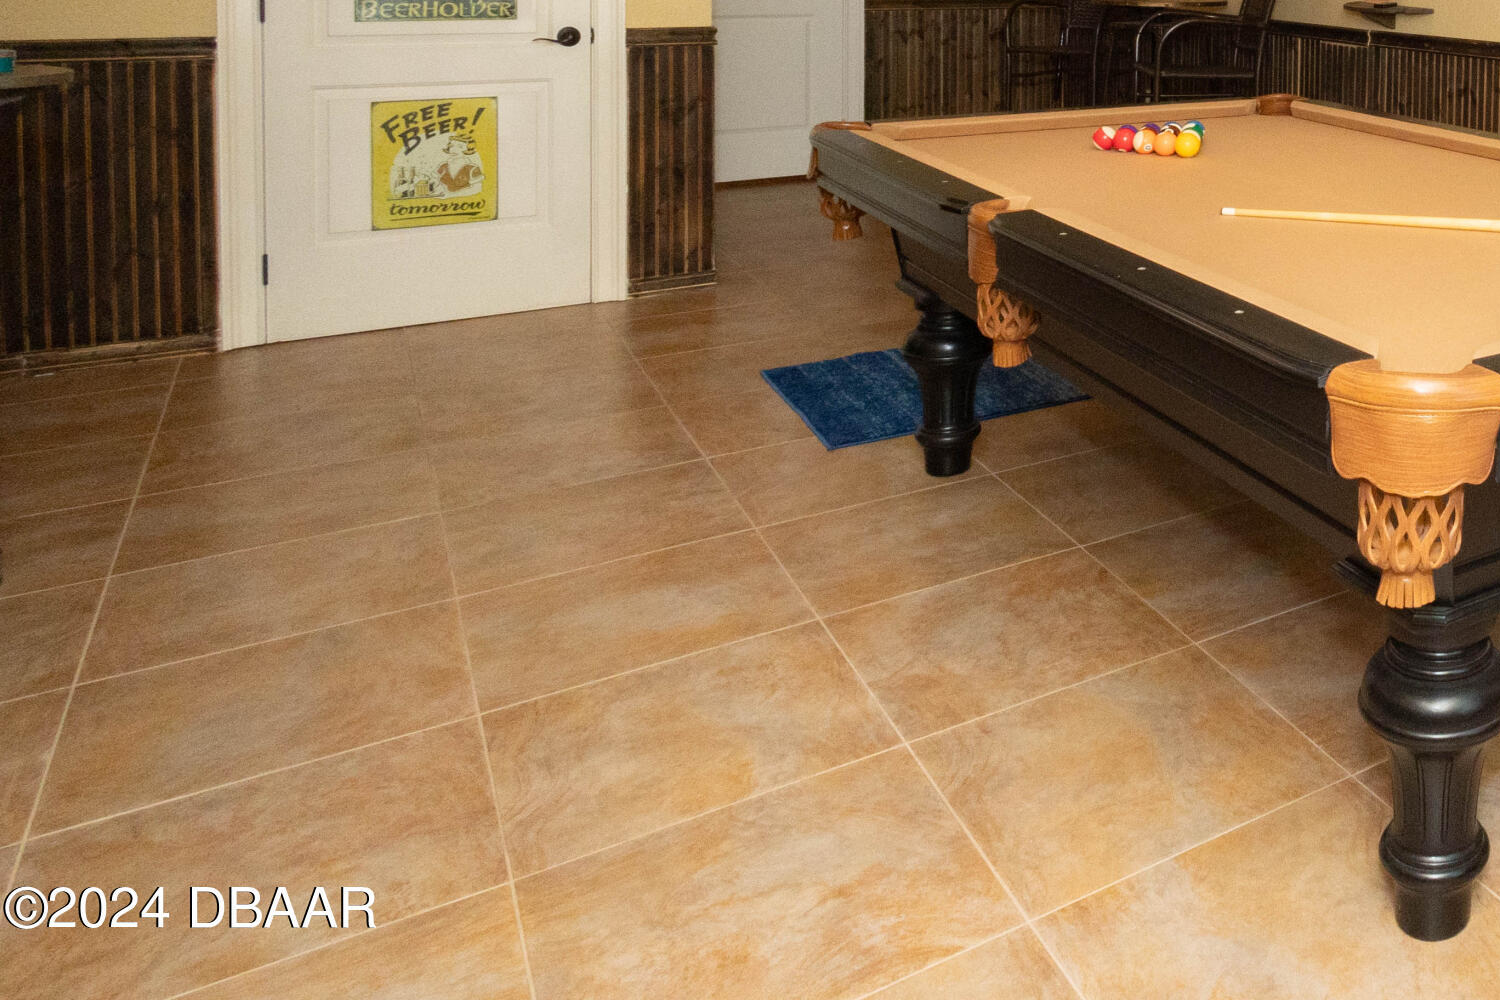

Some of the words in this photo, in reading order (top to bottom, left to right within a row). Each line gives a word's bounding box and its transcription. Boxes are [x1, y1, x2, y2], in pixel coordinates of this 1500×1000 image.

[360, 0, 516, 19] BEERHOLDER
[380, 102, 453, 144] FREE
[389, 199, 486, 217] tomorrow
